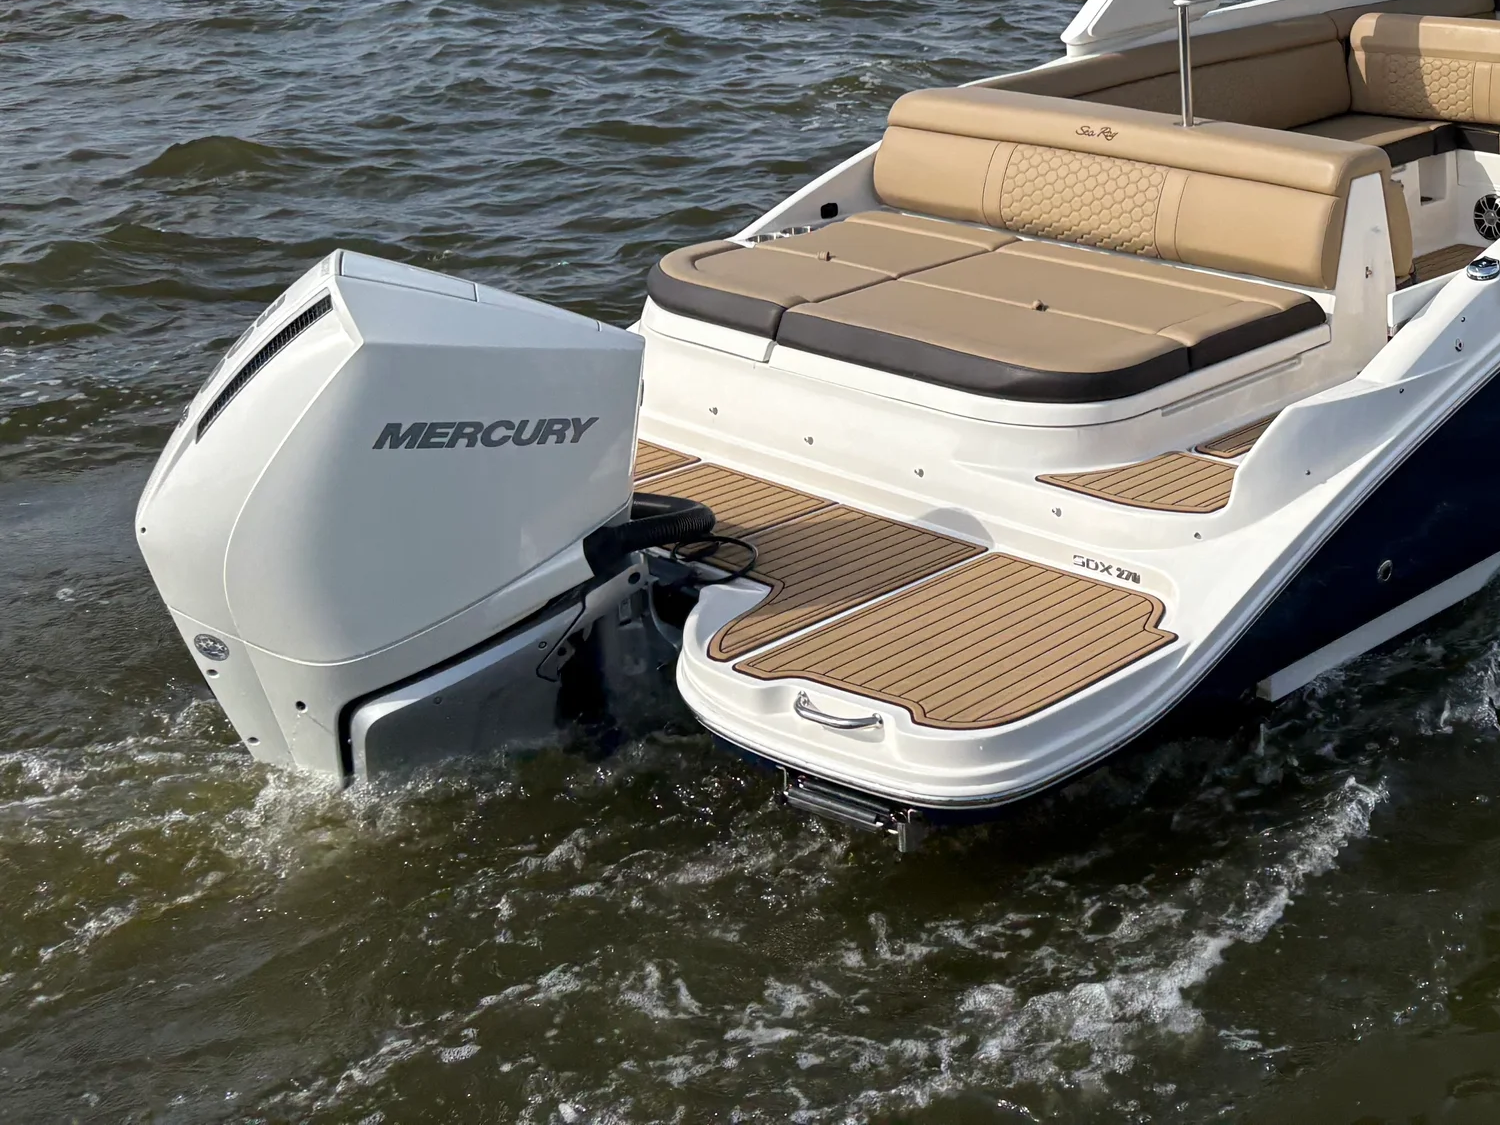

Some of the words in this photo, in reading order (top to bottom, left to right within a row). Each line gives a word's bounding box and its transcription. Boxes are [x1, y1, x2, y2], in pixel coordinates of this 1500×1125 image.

[1075, 125, 1097, 137] Sea
[1096, 126, 1119, 142] Ray
[372, 416, 600, 450] MERCURY
[1072, 554, 1113, 577] SDX
